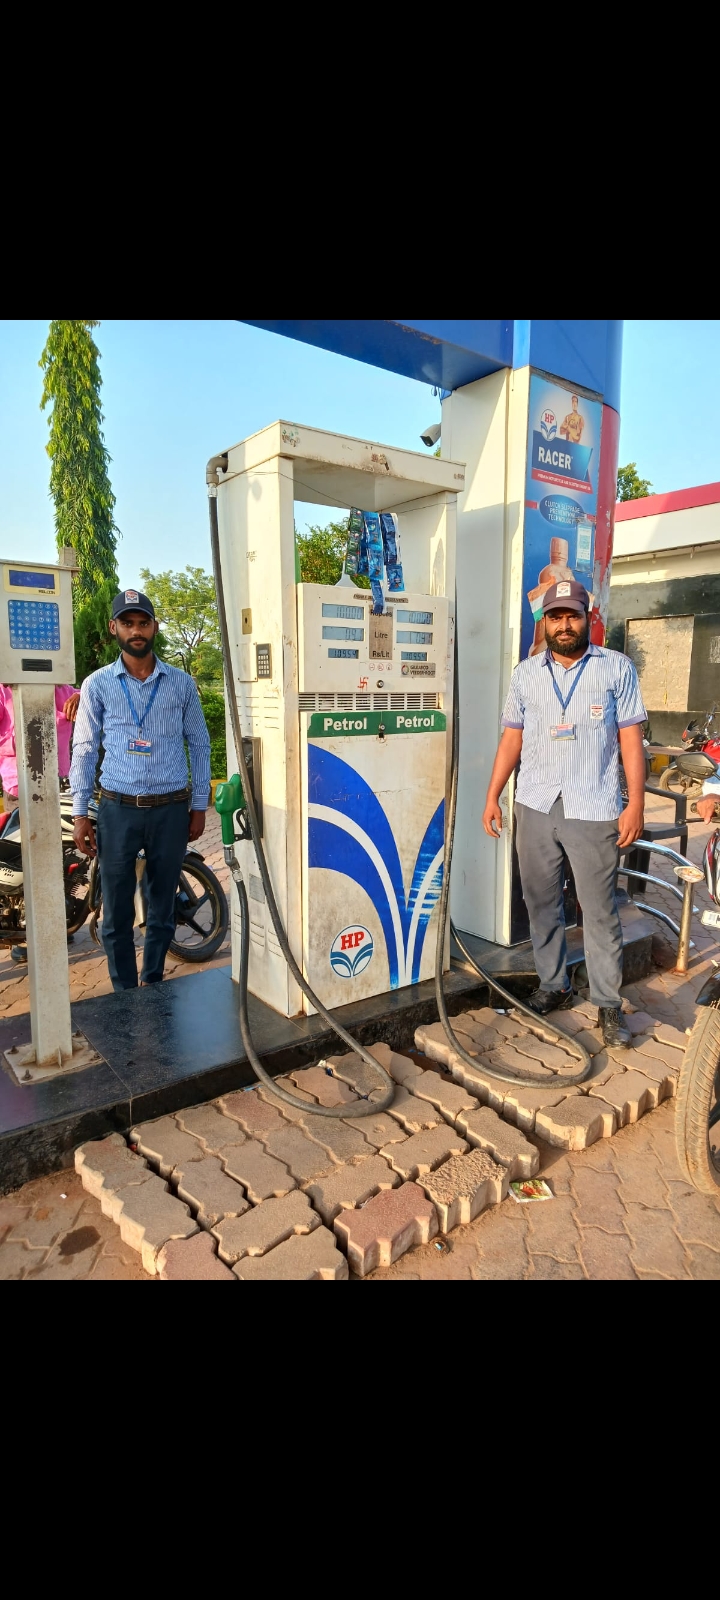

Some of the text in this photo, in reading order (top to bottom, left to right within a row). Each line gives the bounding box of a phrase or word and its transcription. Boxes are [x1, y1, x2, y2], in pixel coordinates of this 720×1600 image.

[544, 413, 554, 424] HP
[538, 446, 571, 470] RACER
[374, 631, 388, 639] Litre
[372, 650, 390, 658] Rs/Lit
[323, 717, 367, 731] Petrol
[396, 714, 435, 729] Petrol
[341, 931, 364, 950] HP
